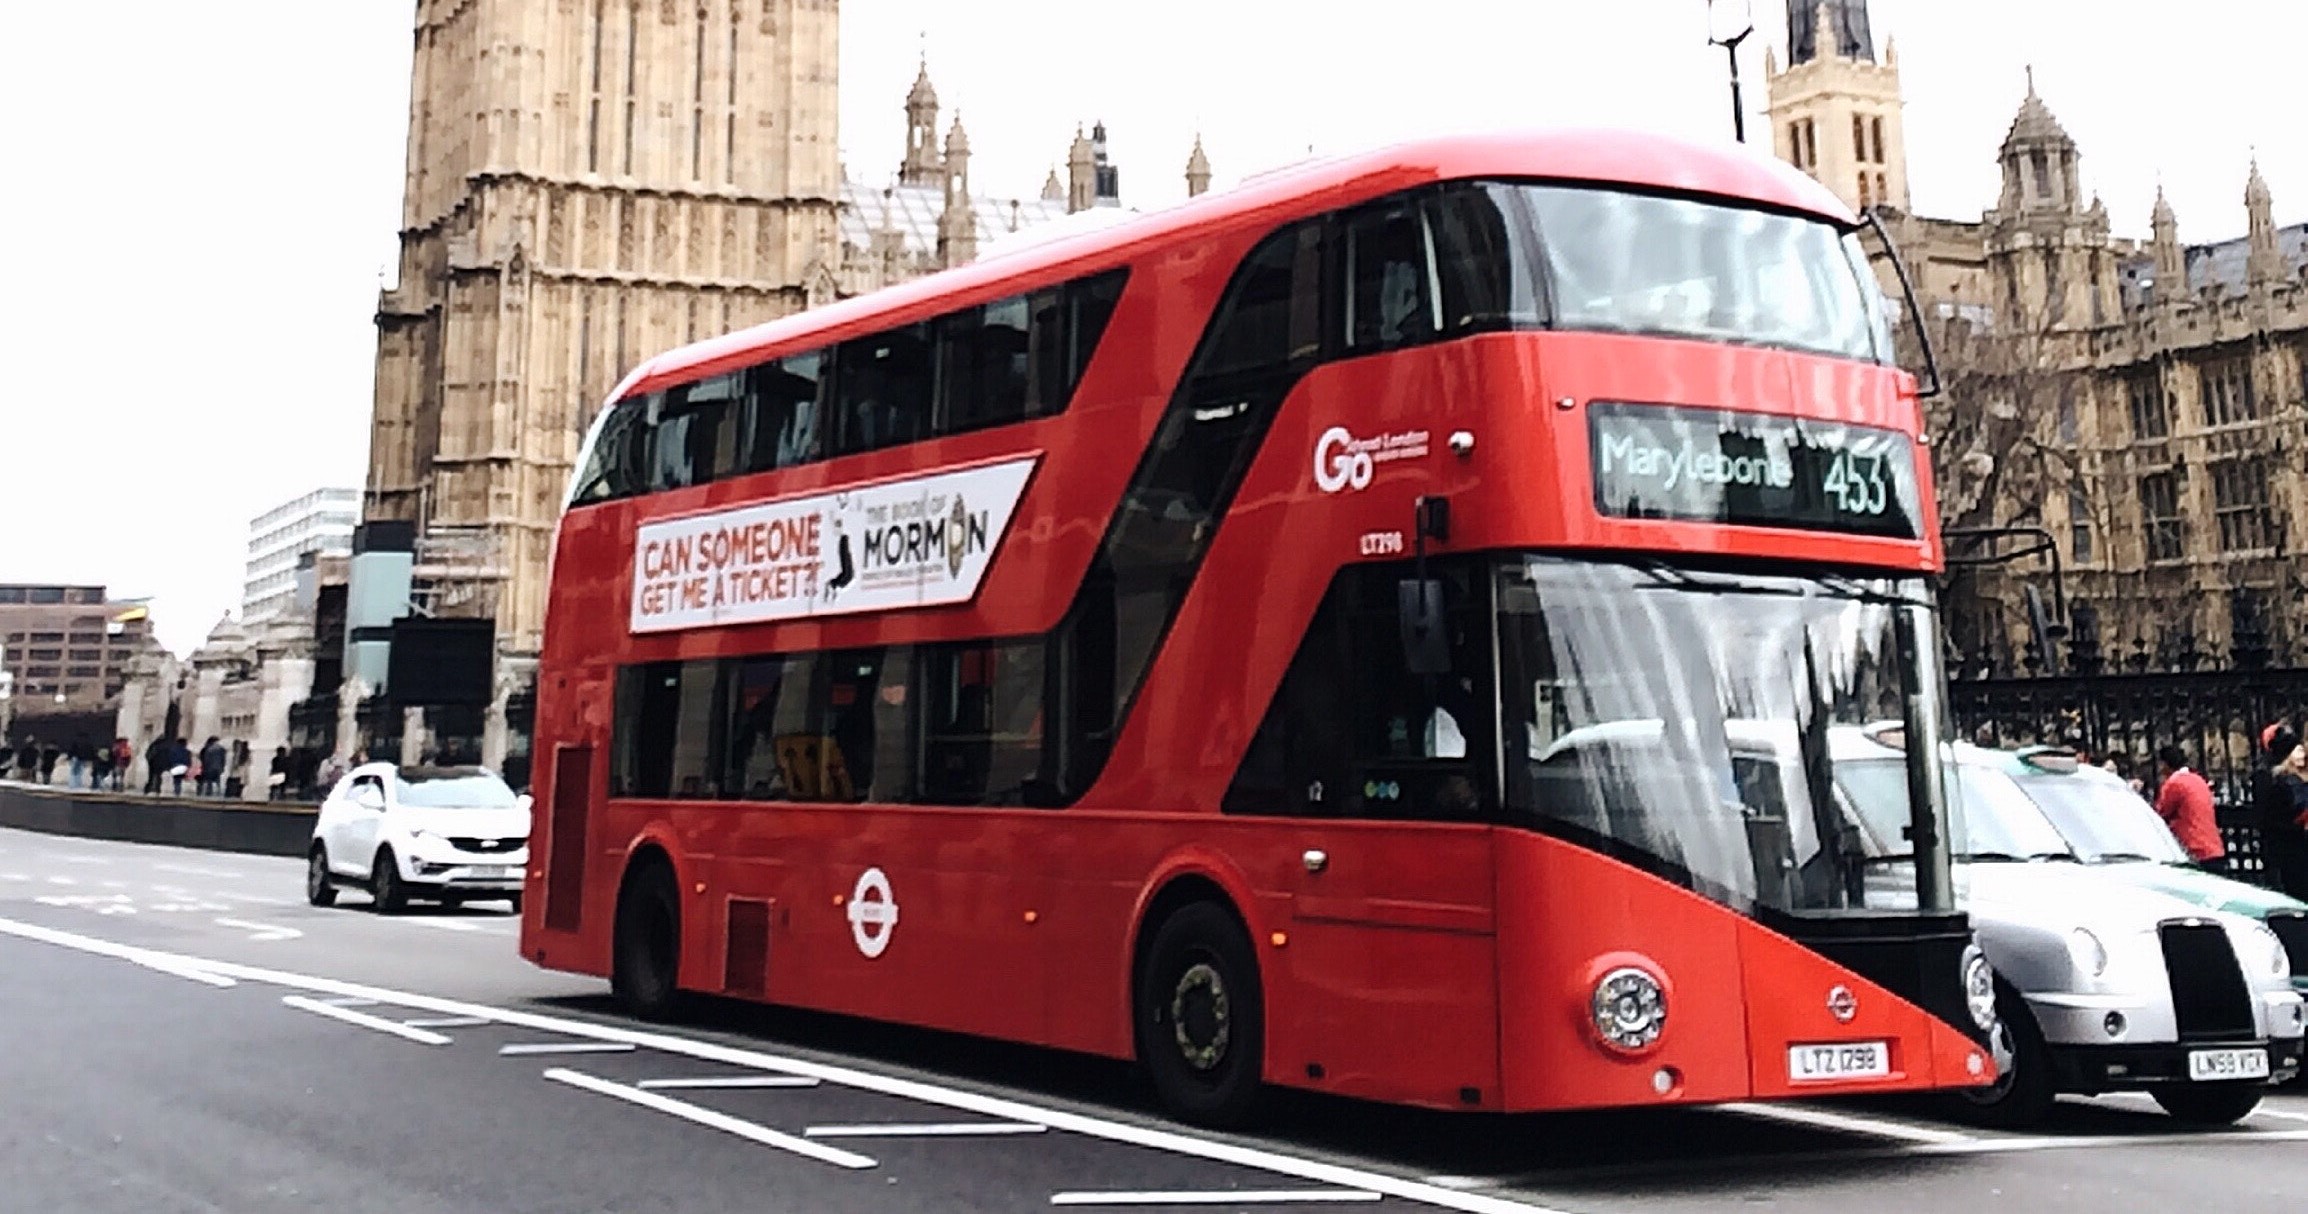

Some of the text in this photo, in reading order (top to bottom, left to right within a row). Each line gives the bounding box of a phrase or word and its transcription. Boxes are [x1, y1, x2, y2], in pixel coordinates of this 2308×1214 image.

[1314, 426, 1373, 492] Go
[1601, 431, 1887, 515] Marylebone 453
[644, 511, 823, 580] CAN SOMEONE
[862, 508, 989, 570] MORMON
[640, 580, 678, 616] GET
[680, 576, 709, 611] ME
[711, 573, 727, 607] A
[1801, 1047, 1877, 1074] LTZ 1298
